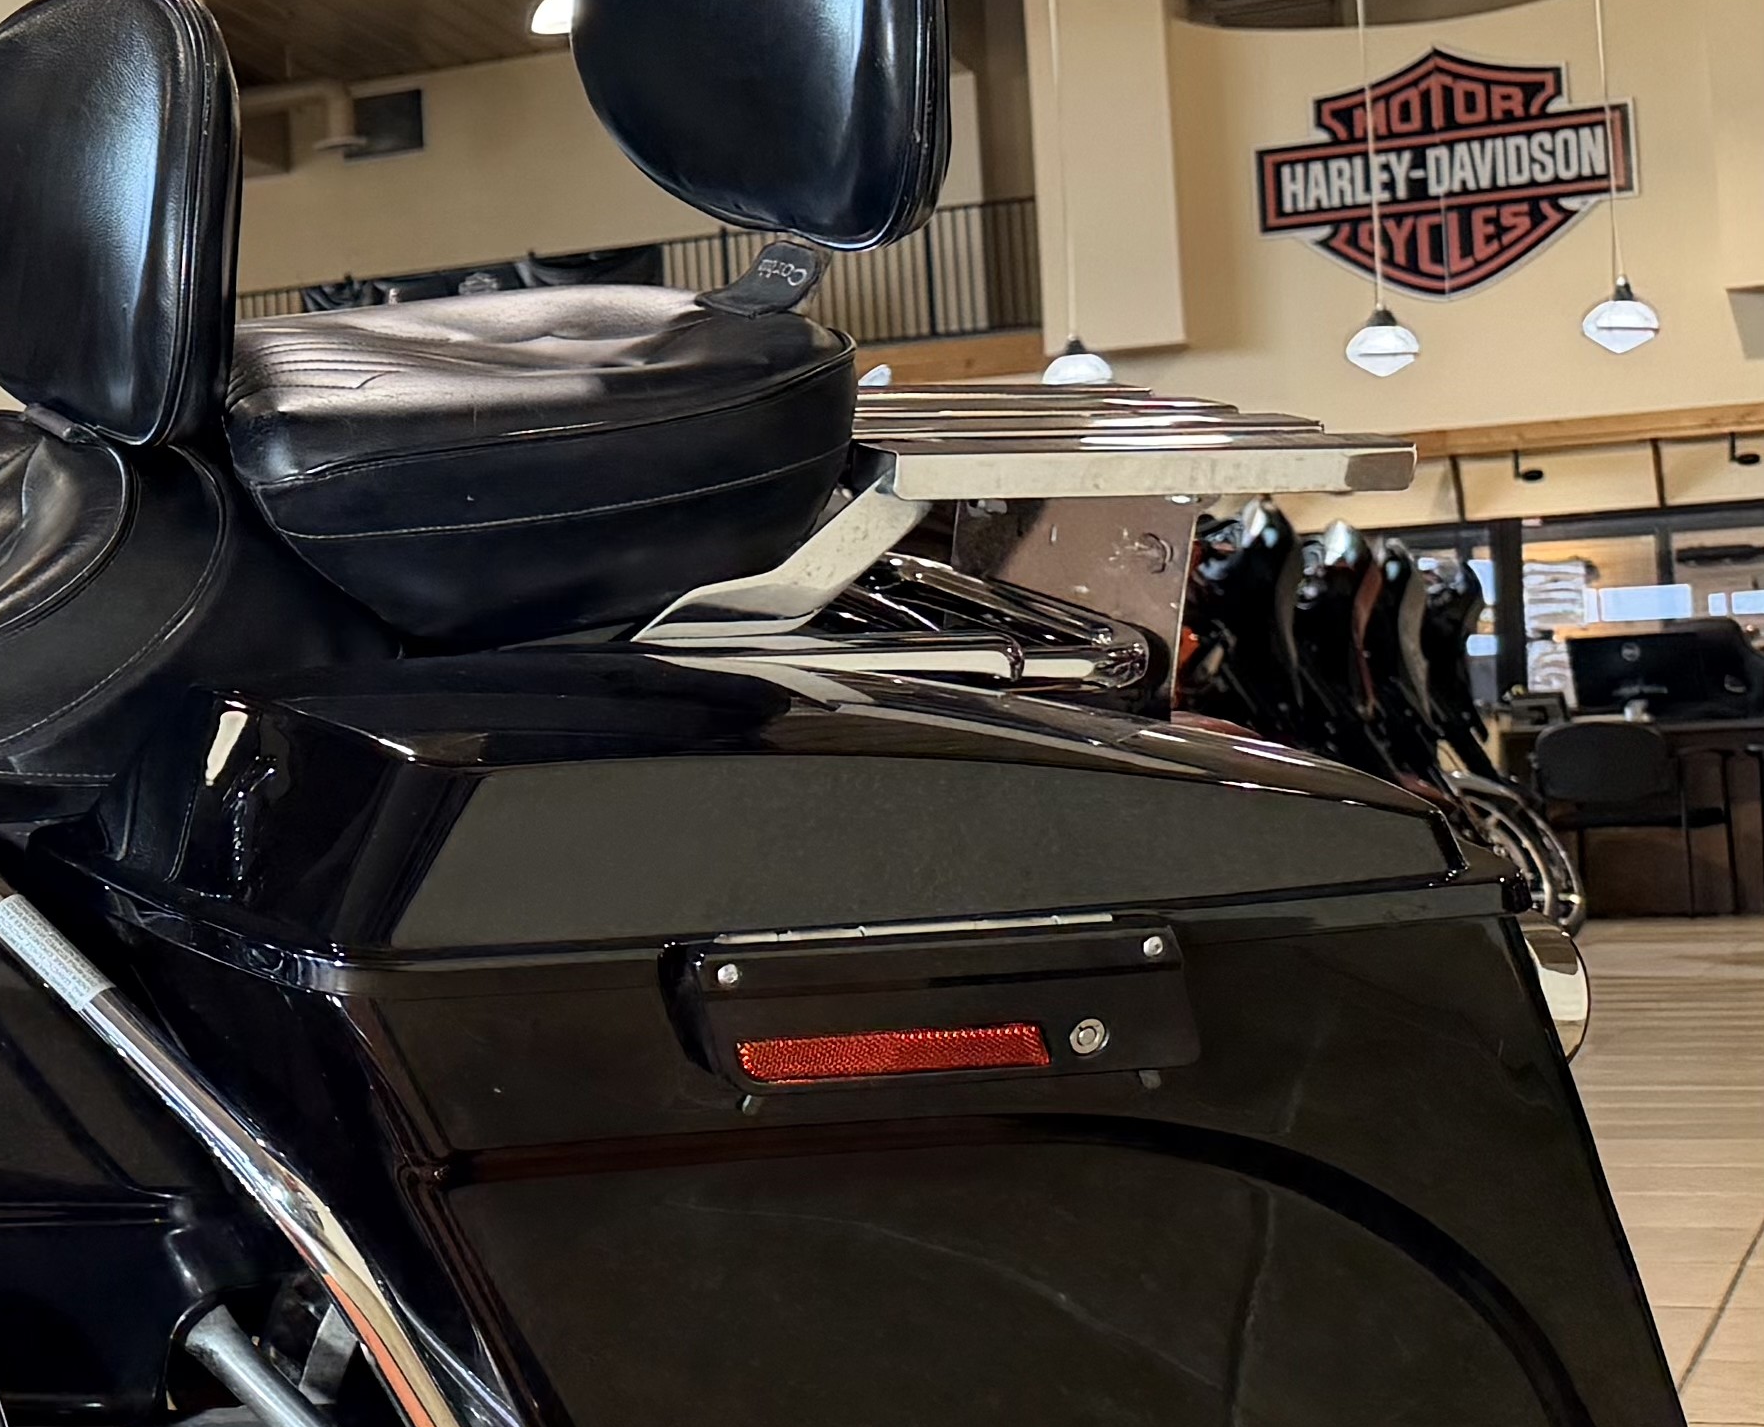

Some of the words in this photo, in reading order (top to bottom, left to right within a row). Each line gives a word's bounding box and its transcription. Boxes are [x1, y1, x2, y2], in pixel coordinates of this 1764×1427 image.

[1352, 73, 1528, 140] MOTOR
[1280, 124, 1609, 214] HARLEY-DAVIDSON
[1369, 203, 1531, 273] CYCLES
